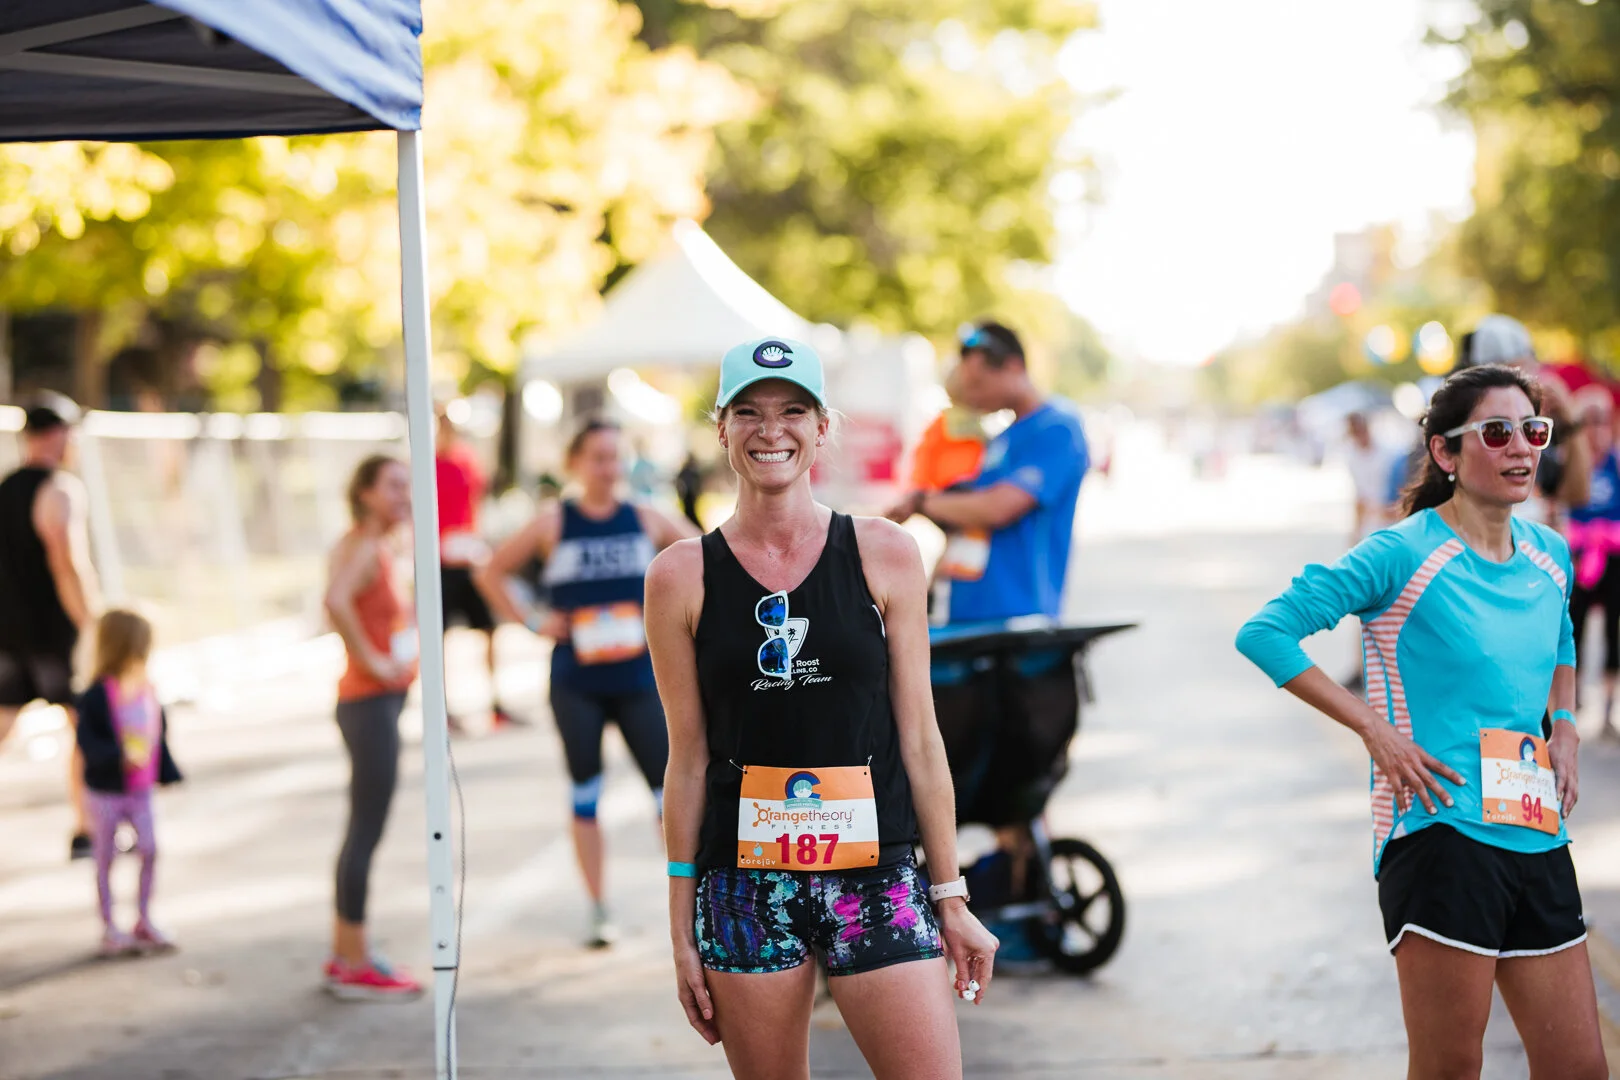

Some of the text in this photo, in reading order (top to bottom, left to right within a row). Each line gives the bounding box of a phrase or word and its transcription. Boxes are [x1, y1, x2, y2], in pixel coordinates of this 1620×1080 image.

[796, 658, 820, 668] Roost
[750, 673, 832, 691] Racing Team
[1521, 793, 1543, 824] 94
[775, 833, 840, 865] 187
